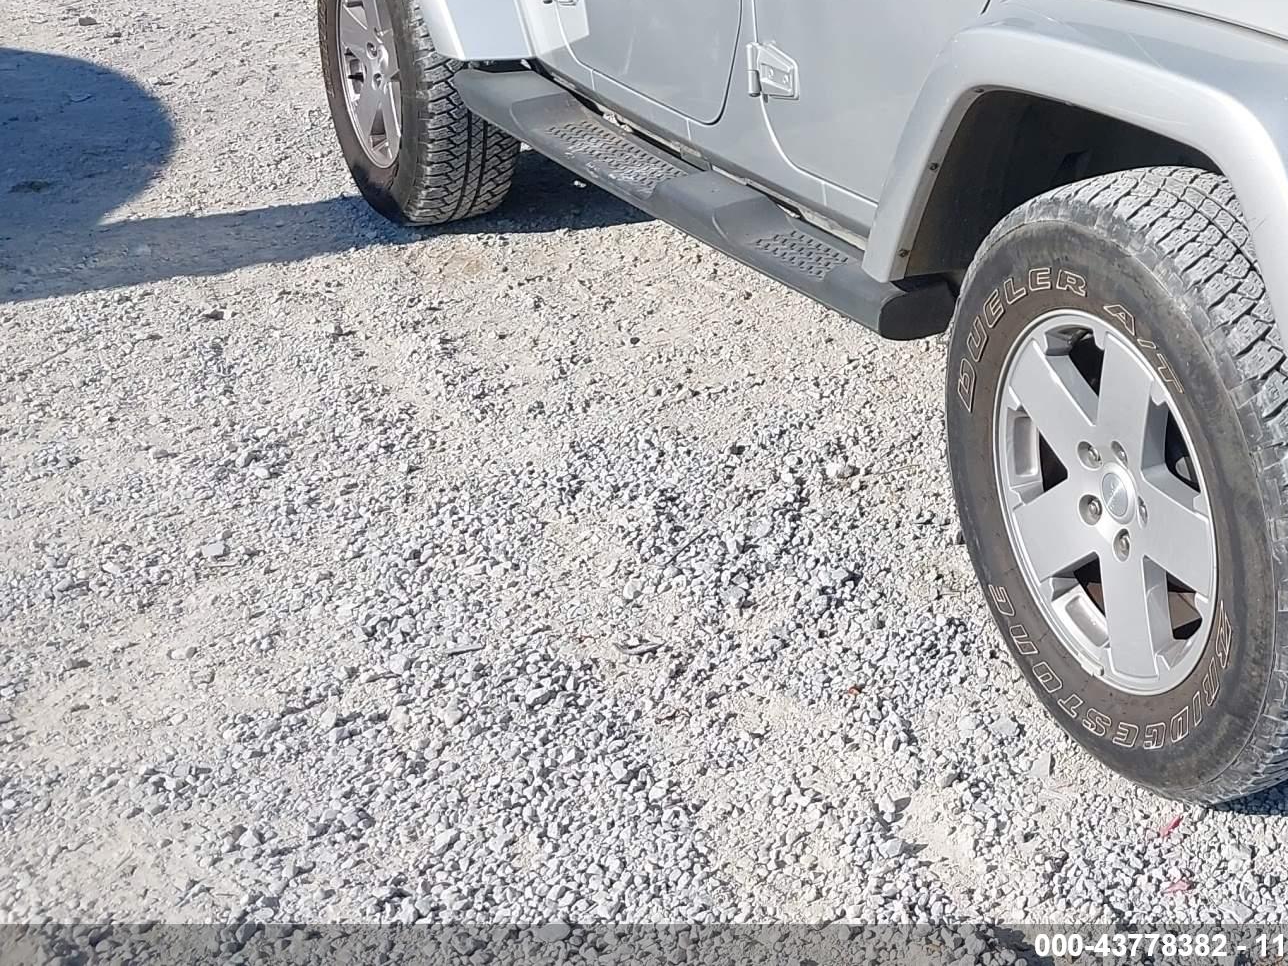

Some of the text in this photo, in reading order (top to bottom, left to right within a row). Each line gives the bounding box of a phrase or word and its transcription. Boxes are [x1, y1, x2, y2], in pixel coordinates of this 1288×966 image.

[957, 267, 1185, 413] DUELER A/T
[988, 584, 1233, 751] BRIDGESTONE
